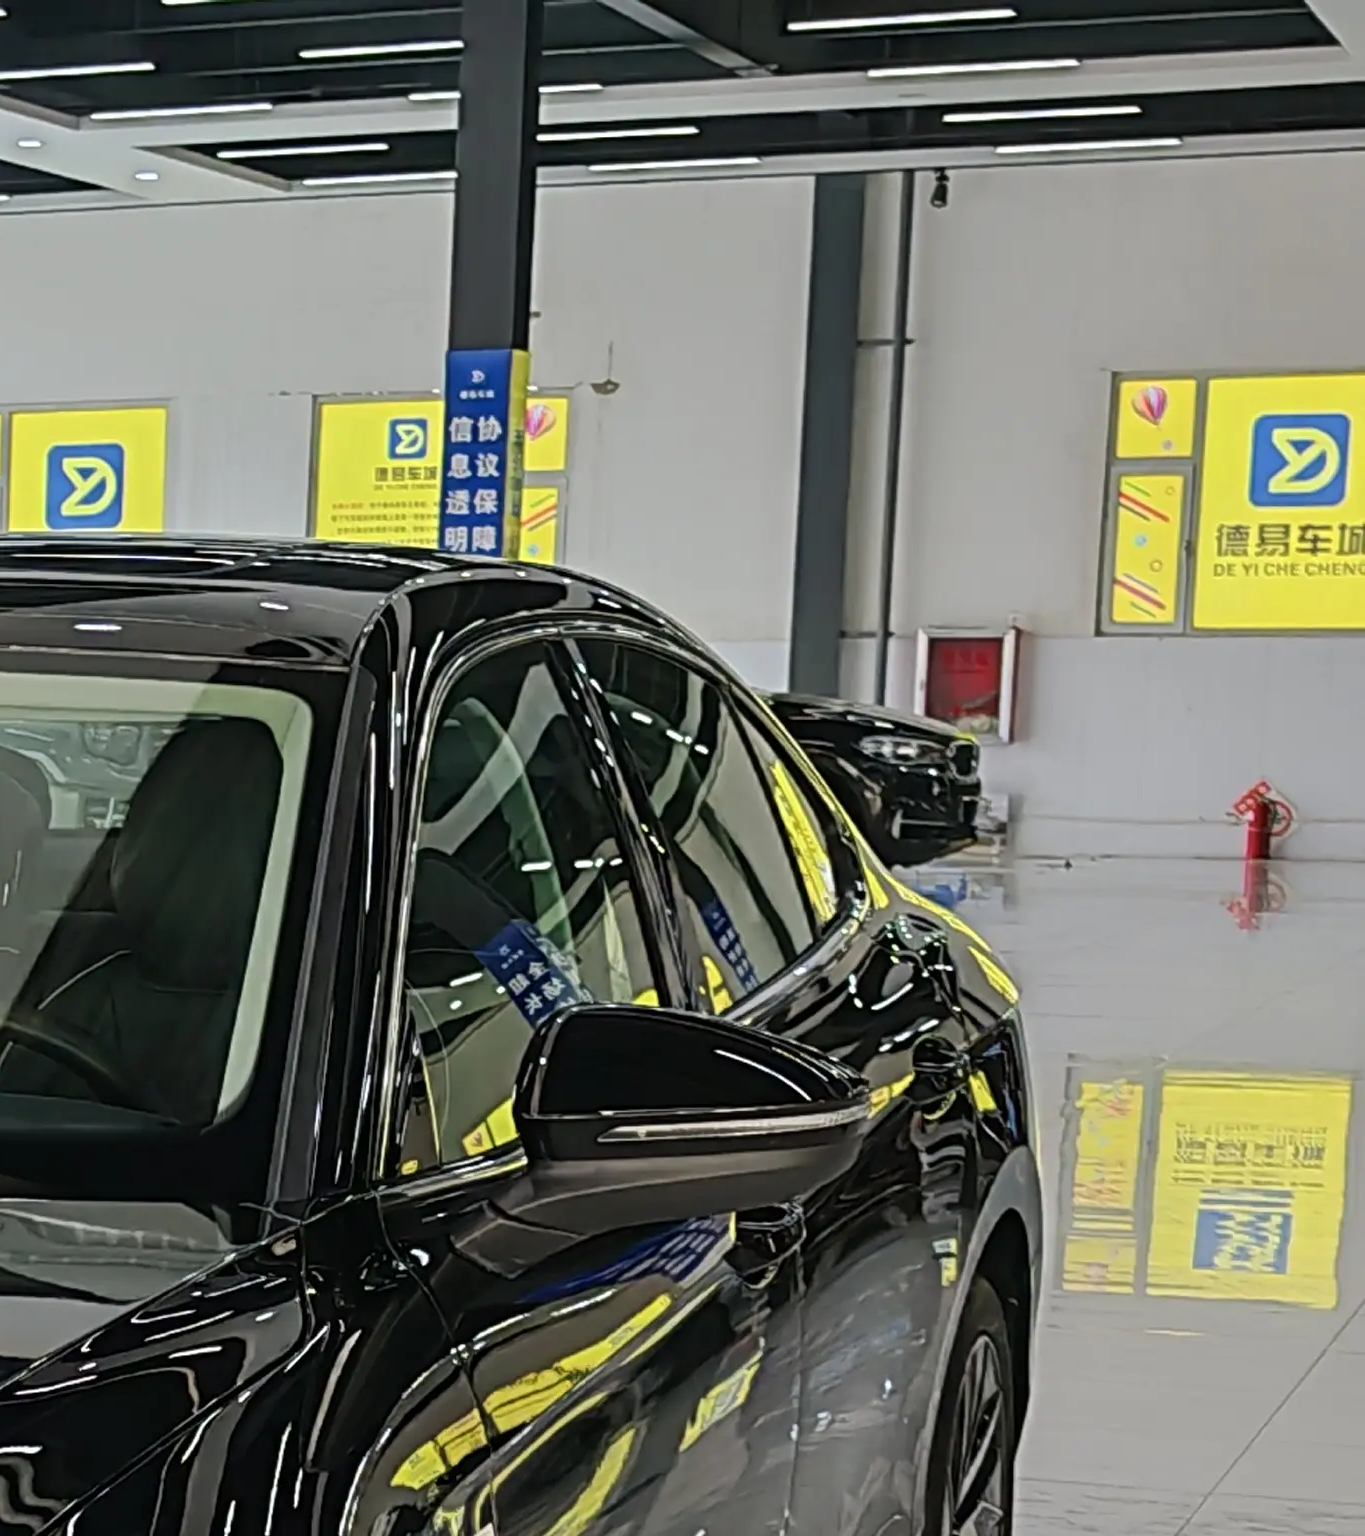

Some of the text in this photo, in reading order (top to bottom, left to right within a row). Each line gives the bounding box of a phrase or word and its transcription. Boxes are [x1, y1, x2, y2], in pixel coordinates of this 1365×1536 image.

[1215, 522, 1365, 558] 德易车城
[1213, 563, 1237, 577] DE
[1241, 563, 1259, 577] YI
[1263, 563, 1300, 577] CHE
